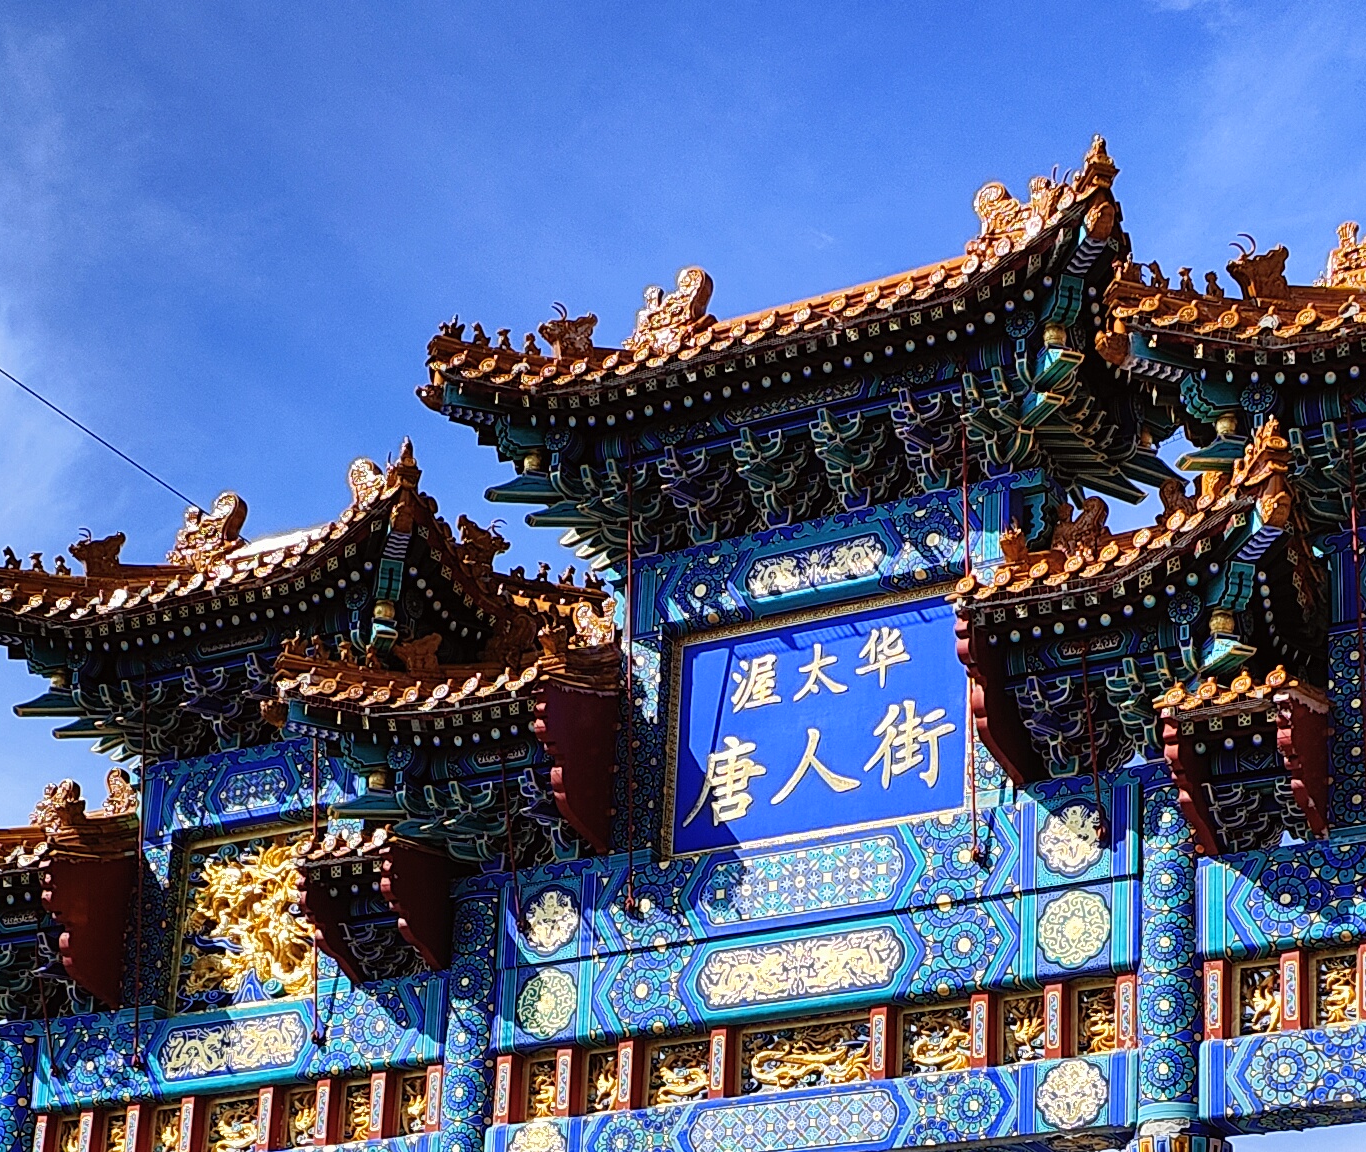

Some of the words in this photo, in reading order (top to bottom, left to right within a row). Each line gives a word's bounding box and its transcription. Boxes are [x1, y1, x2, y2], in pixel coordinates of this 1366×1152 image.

[730, 626, 911, 714] 渥太华
[682, 700, 956, 827] 唐人街
